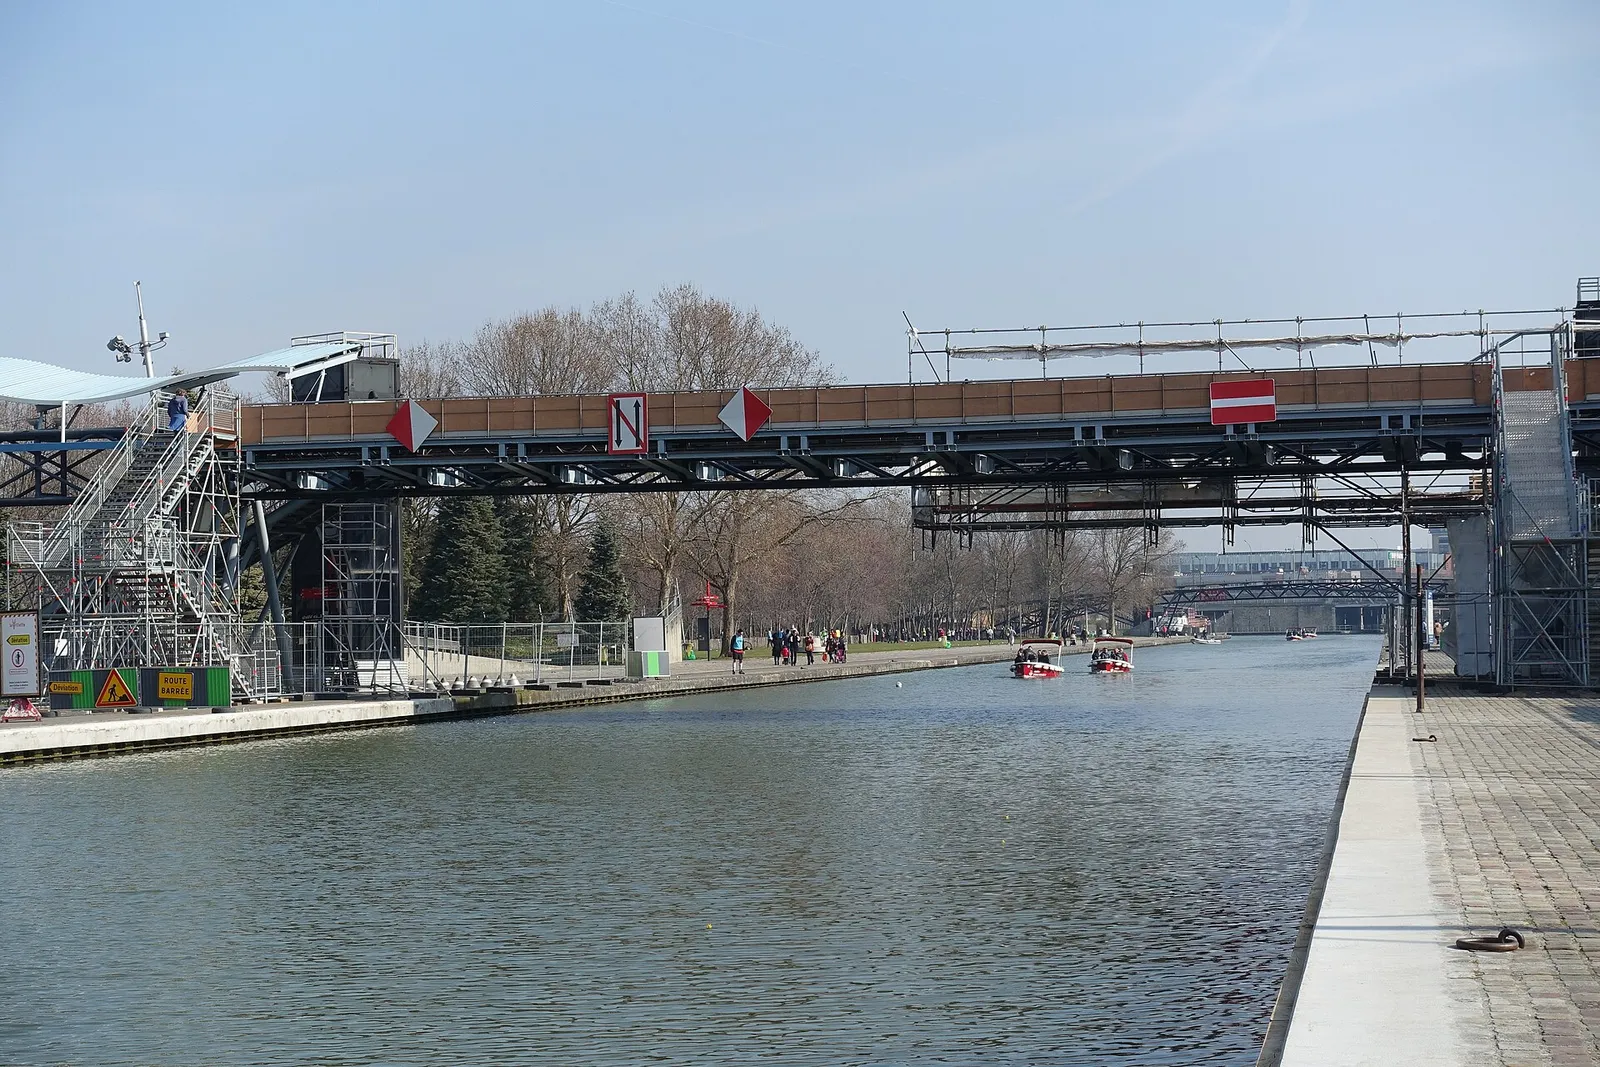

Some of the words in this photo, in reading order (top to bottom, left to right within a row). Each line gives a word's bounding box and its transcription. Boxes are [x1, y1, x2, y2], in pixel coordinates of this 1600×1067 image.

[164, 677, 187, 685] ROUTE
[53, 684, 79, 692] Déviation
[161, 687, 189, 695] BARRÉE
